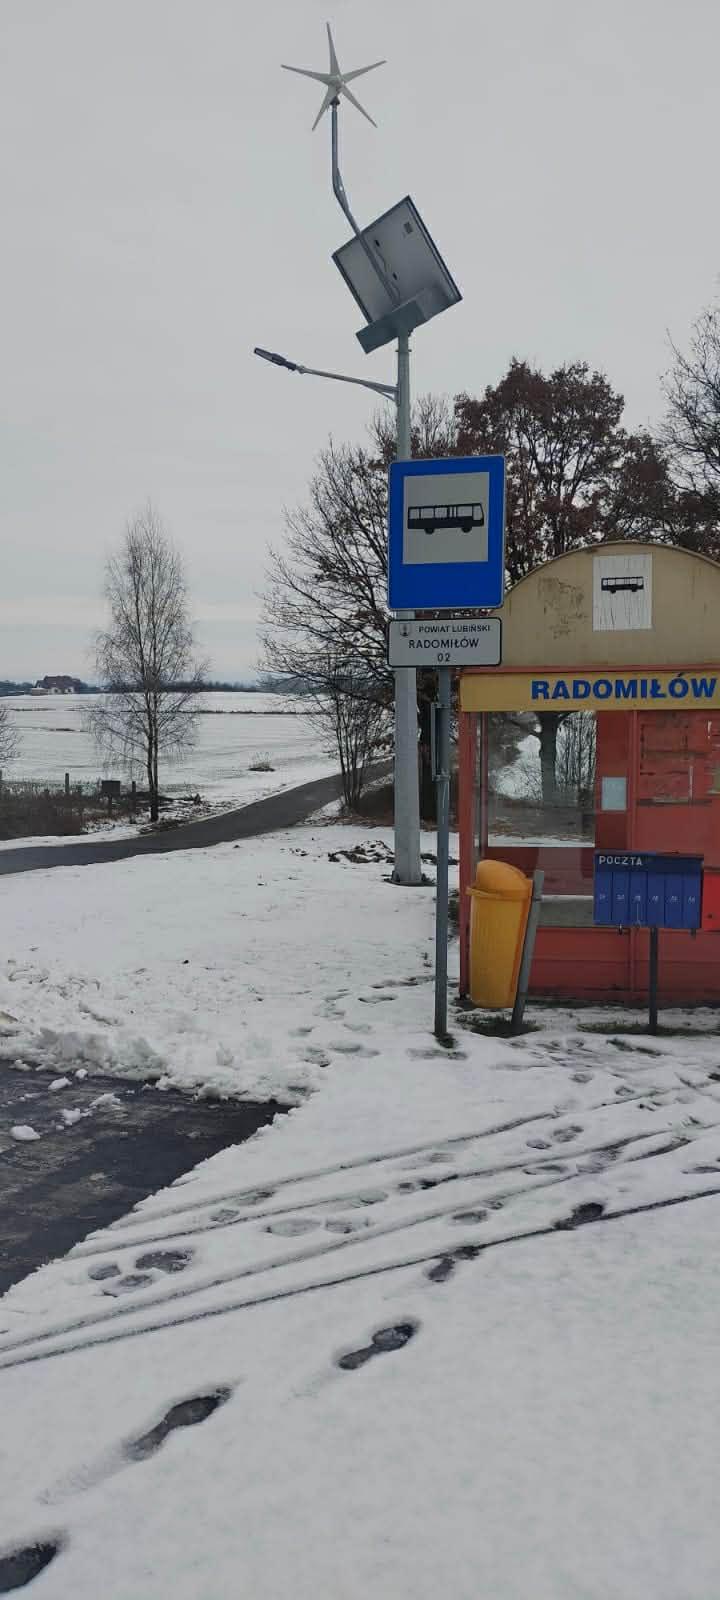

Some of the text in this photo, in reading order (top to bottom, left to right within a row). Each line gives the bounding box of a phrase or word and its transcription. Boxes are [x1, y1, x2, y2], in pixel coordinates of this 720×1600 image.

[418, 623, 490, 633] POWIAT LUBIŃSKI
[408, 636, 479, 649] RADOMIŁÓW
[437, 653, 450, 662] 02
[531, 672, 717, 699] RADOMIŁÓW
[598, 855, 643, 866] POCZTA
